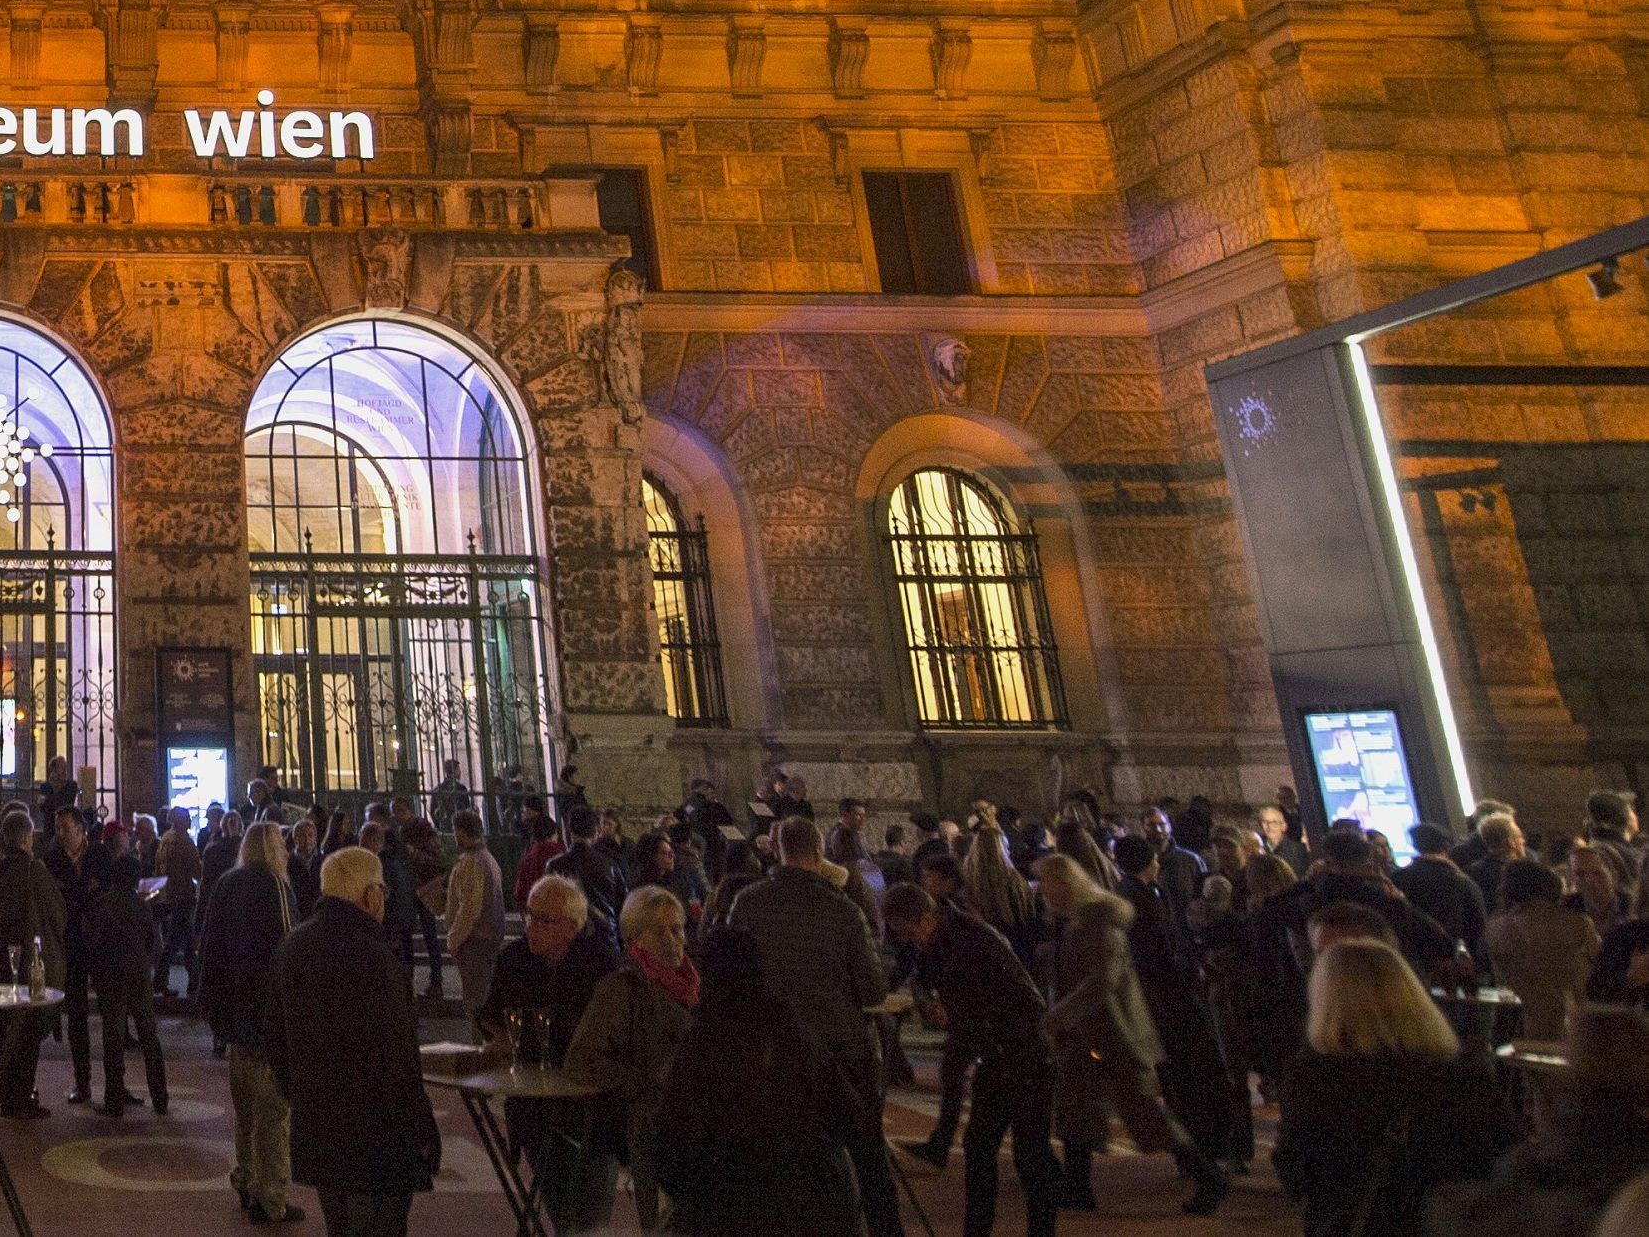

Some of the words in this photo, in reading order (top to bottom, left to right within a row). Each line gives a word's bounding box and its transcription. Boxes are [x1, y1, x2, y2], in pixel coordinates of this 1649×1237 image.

[184, 89, 374, 159] wien
[356, 399, 402, 408] HOFJAGD
[346, 415, 414, 425] RSMMER
